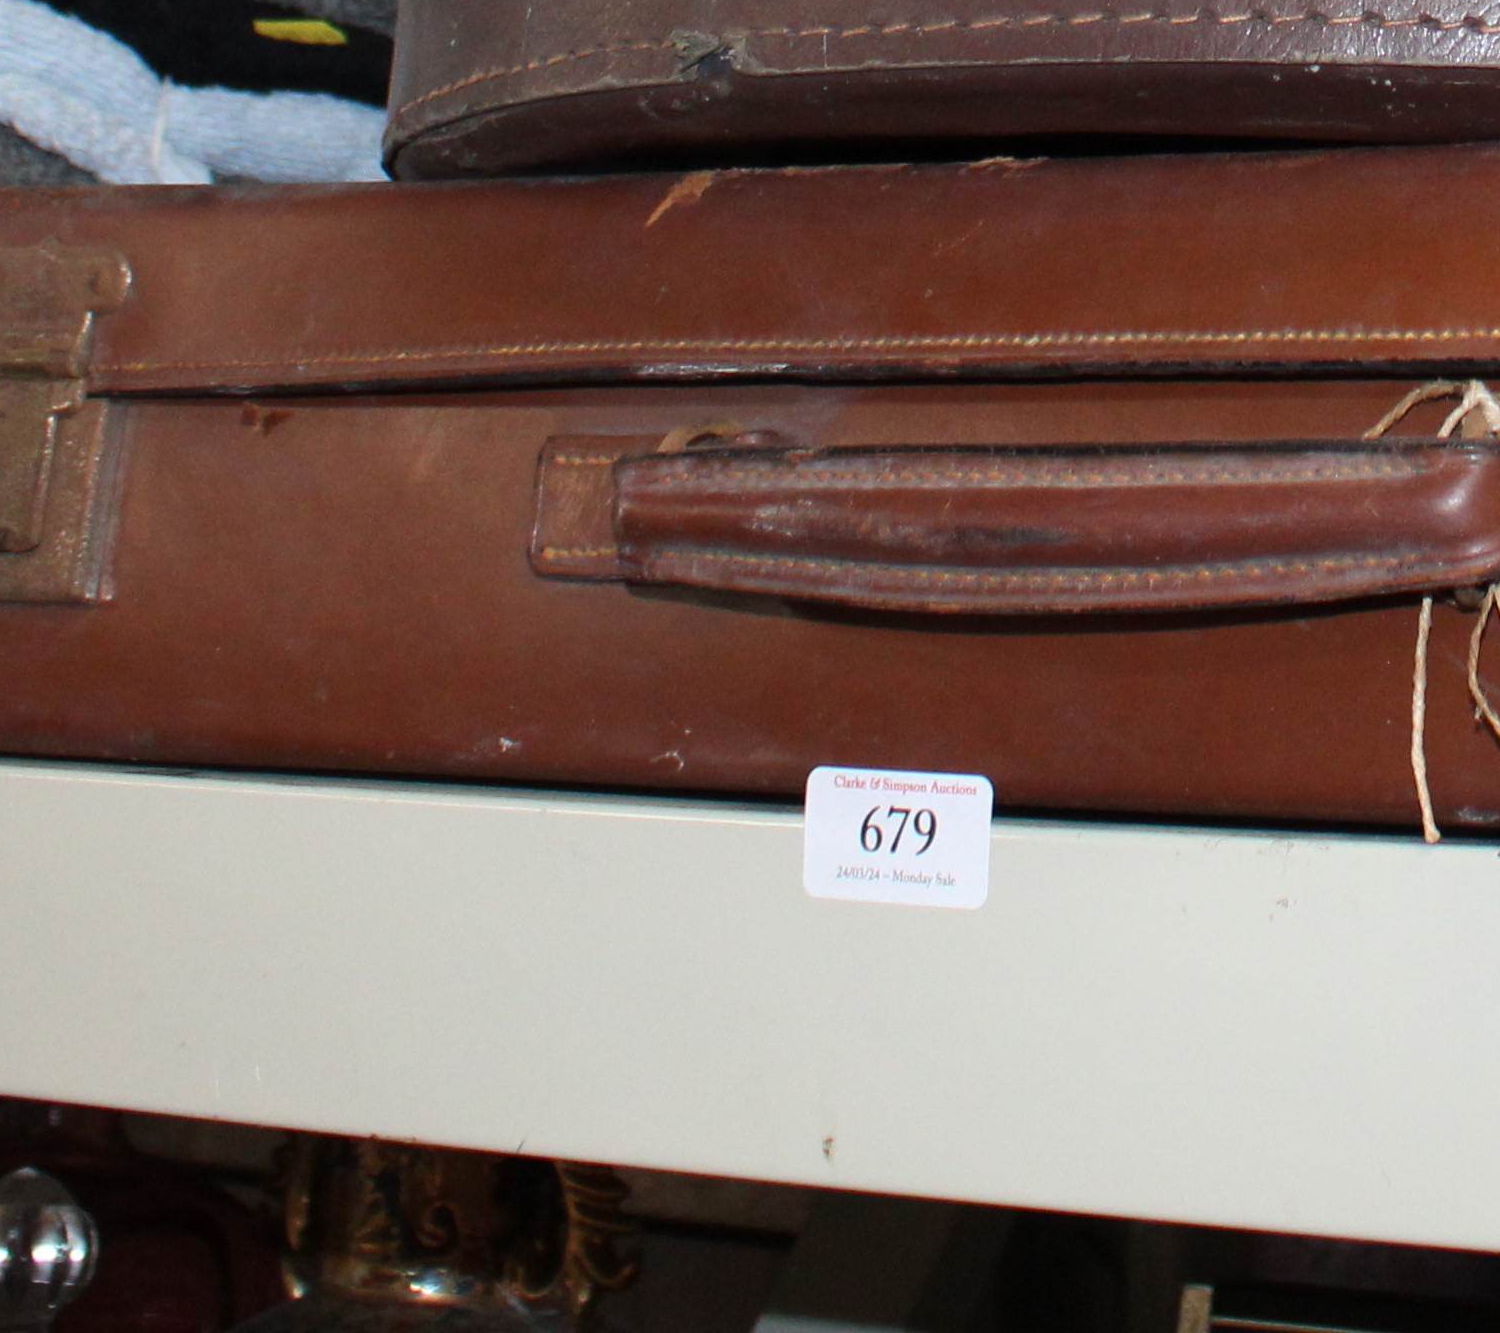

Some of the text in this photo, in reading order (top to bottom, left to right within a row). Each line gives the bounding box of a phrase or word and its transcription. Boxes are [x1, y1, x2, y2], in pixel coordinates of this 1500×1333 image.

[834, 775, 978, 795] Clarke & Simpson Auctions
[860, 805, 937, 856] 679
[892, 869, 933, 888] Monday
[936, 872, 957, 886] Sale
